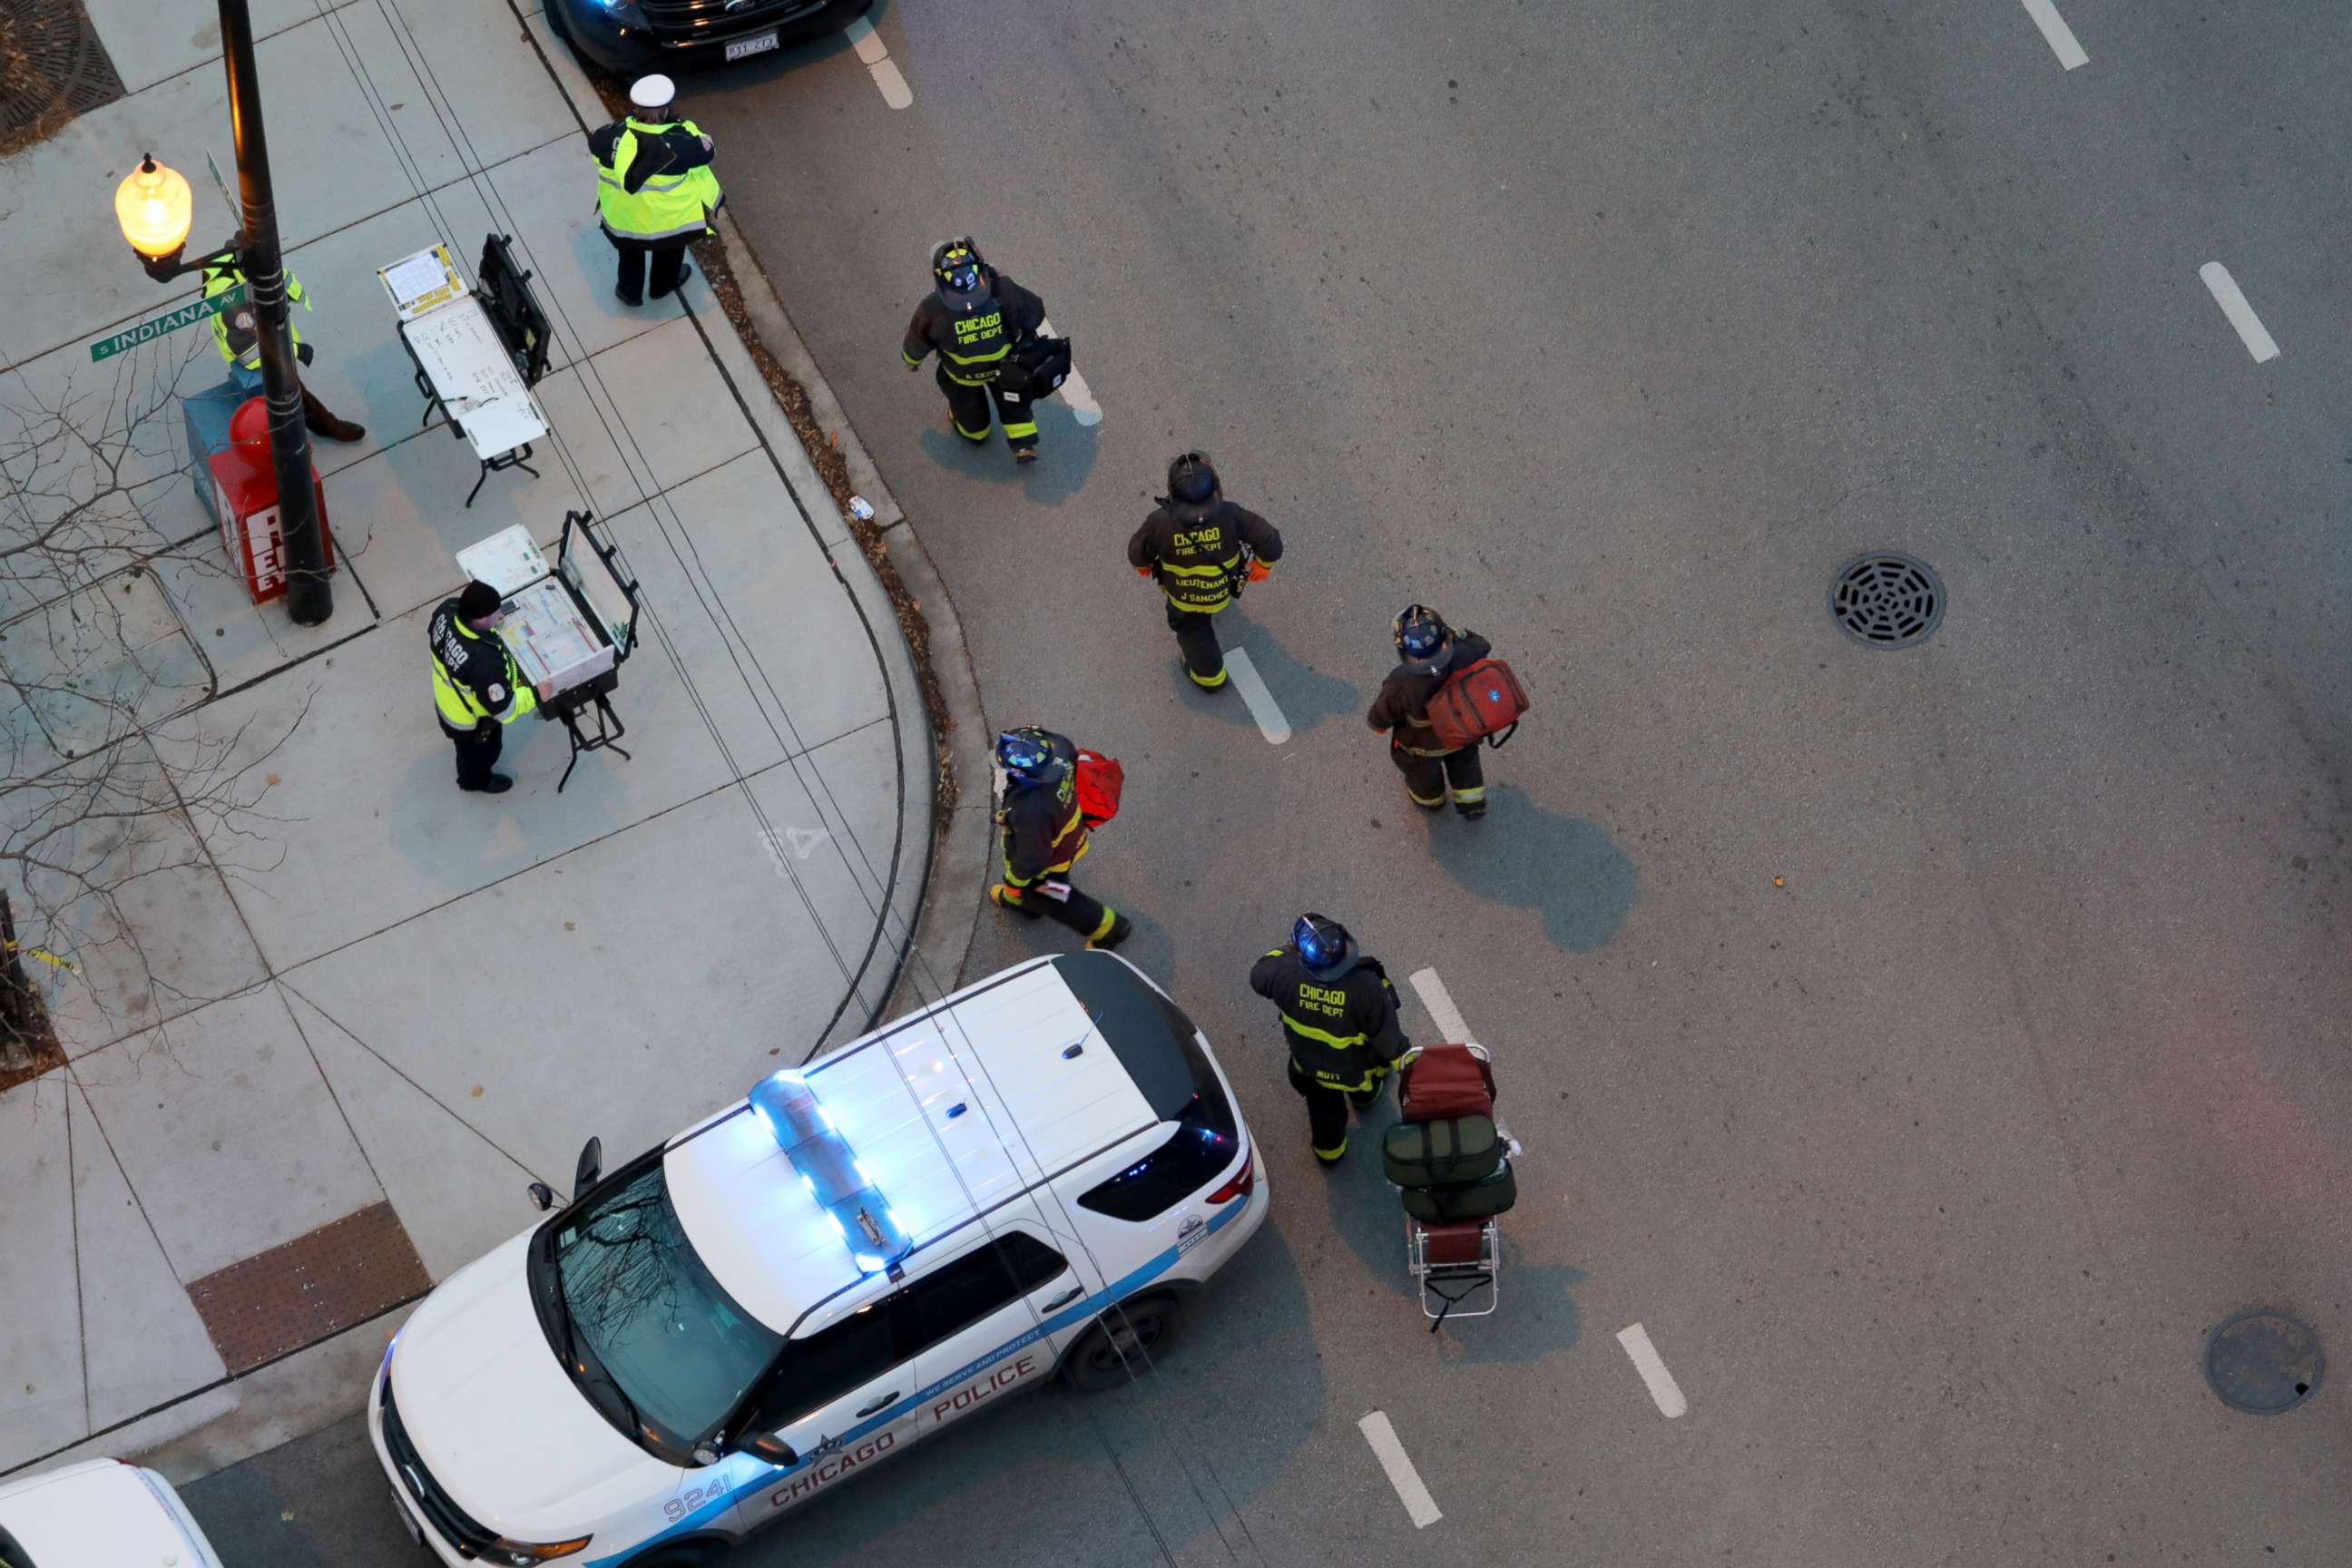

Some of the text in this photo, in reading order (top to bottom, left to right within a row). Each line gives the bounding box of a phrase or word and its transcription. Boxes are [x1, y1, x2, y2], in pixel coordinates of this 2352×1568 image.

[100, 292, 236, 355] S INDIANA AV
[955, 312, 1001, 335] CHICAGO
[958, 325, 1002, 345] FIRE DEPT
[1176, 546, 1197, 555] FIRE
[1176, 575, 1229, 589] LIEUTENANT
[1181, 588, 1230, 603] J SANCHEZ
[1299, 984, 1346, 1005] CHICAGO
[1299, 999, 1343, 1018] FIRE DEPT
[926, 1329, 1040, 1396] WE SERVE AND PROTECT
[771, 1356, 1036, 1508] CHICAGO POLICE
[663, 1474, 732, 1523] 9241
